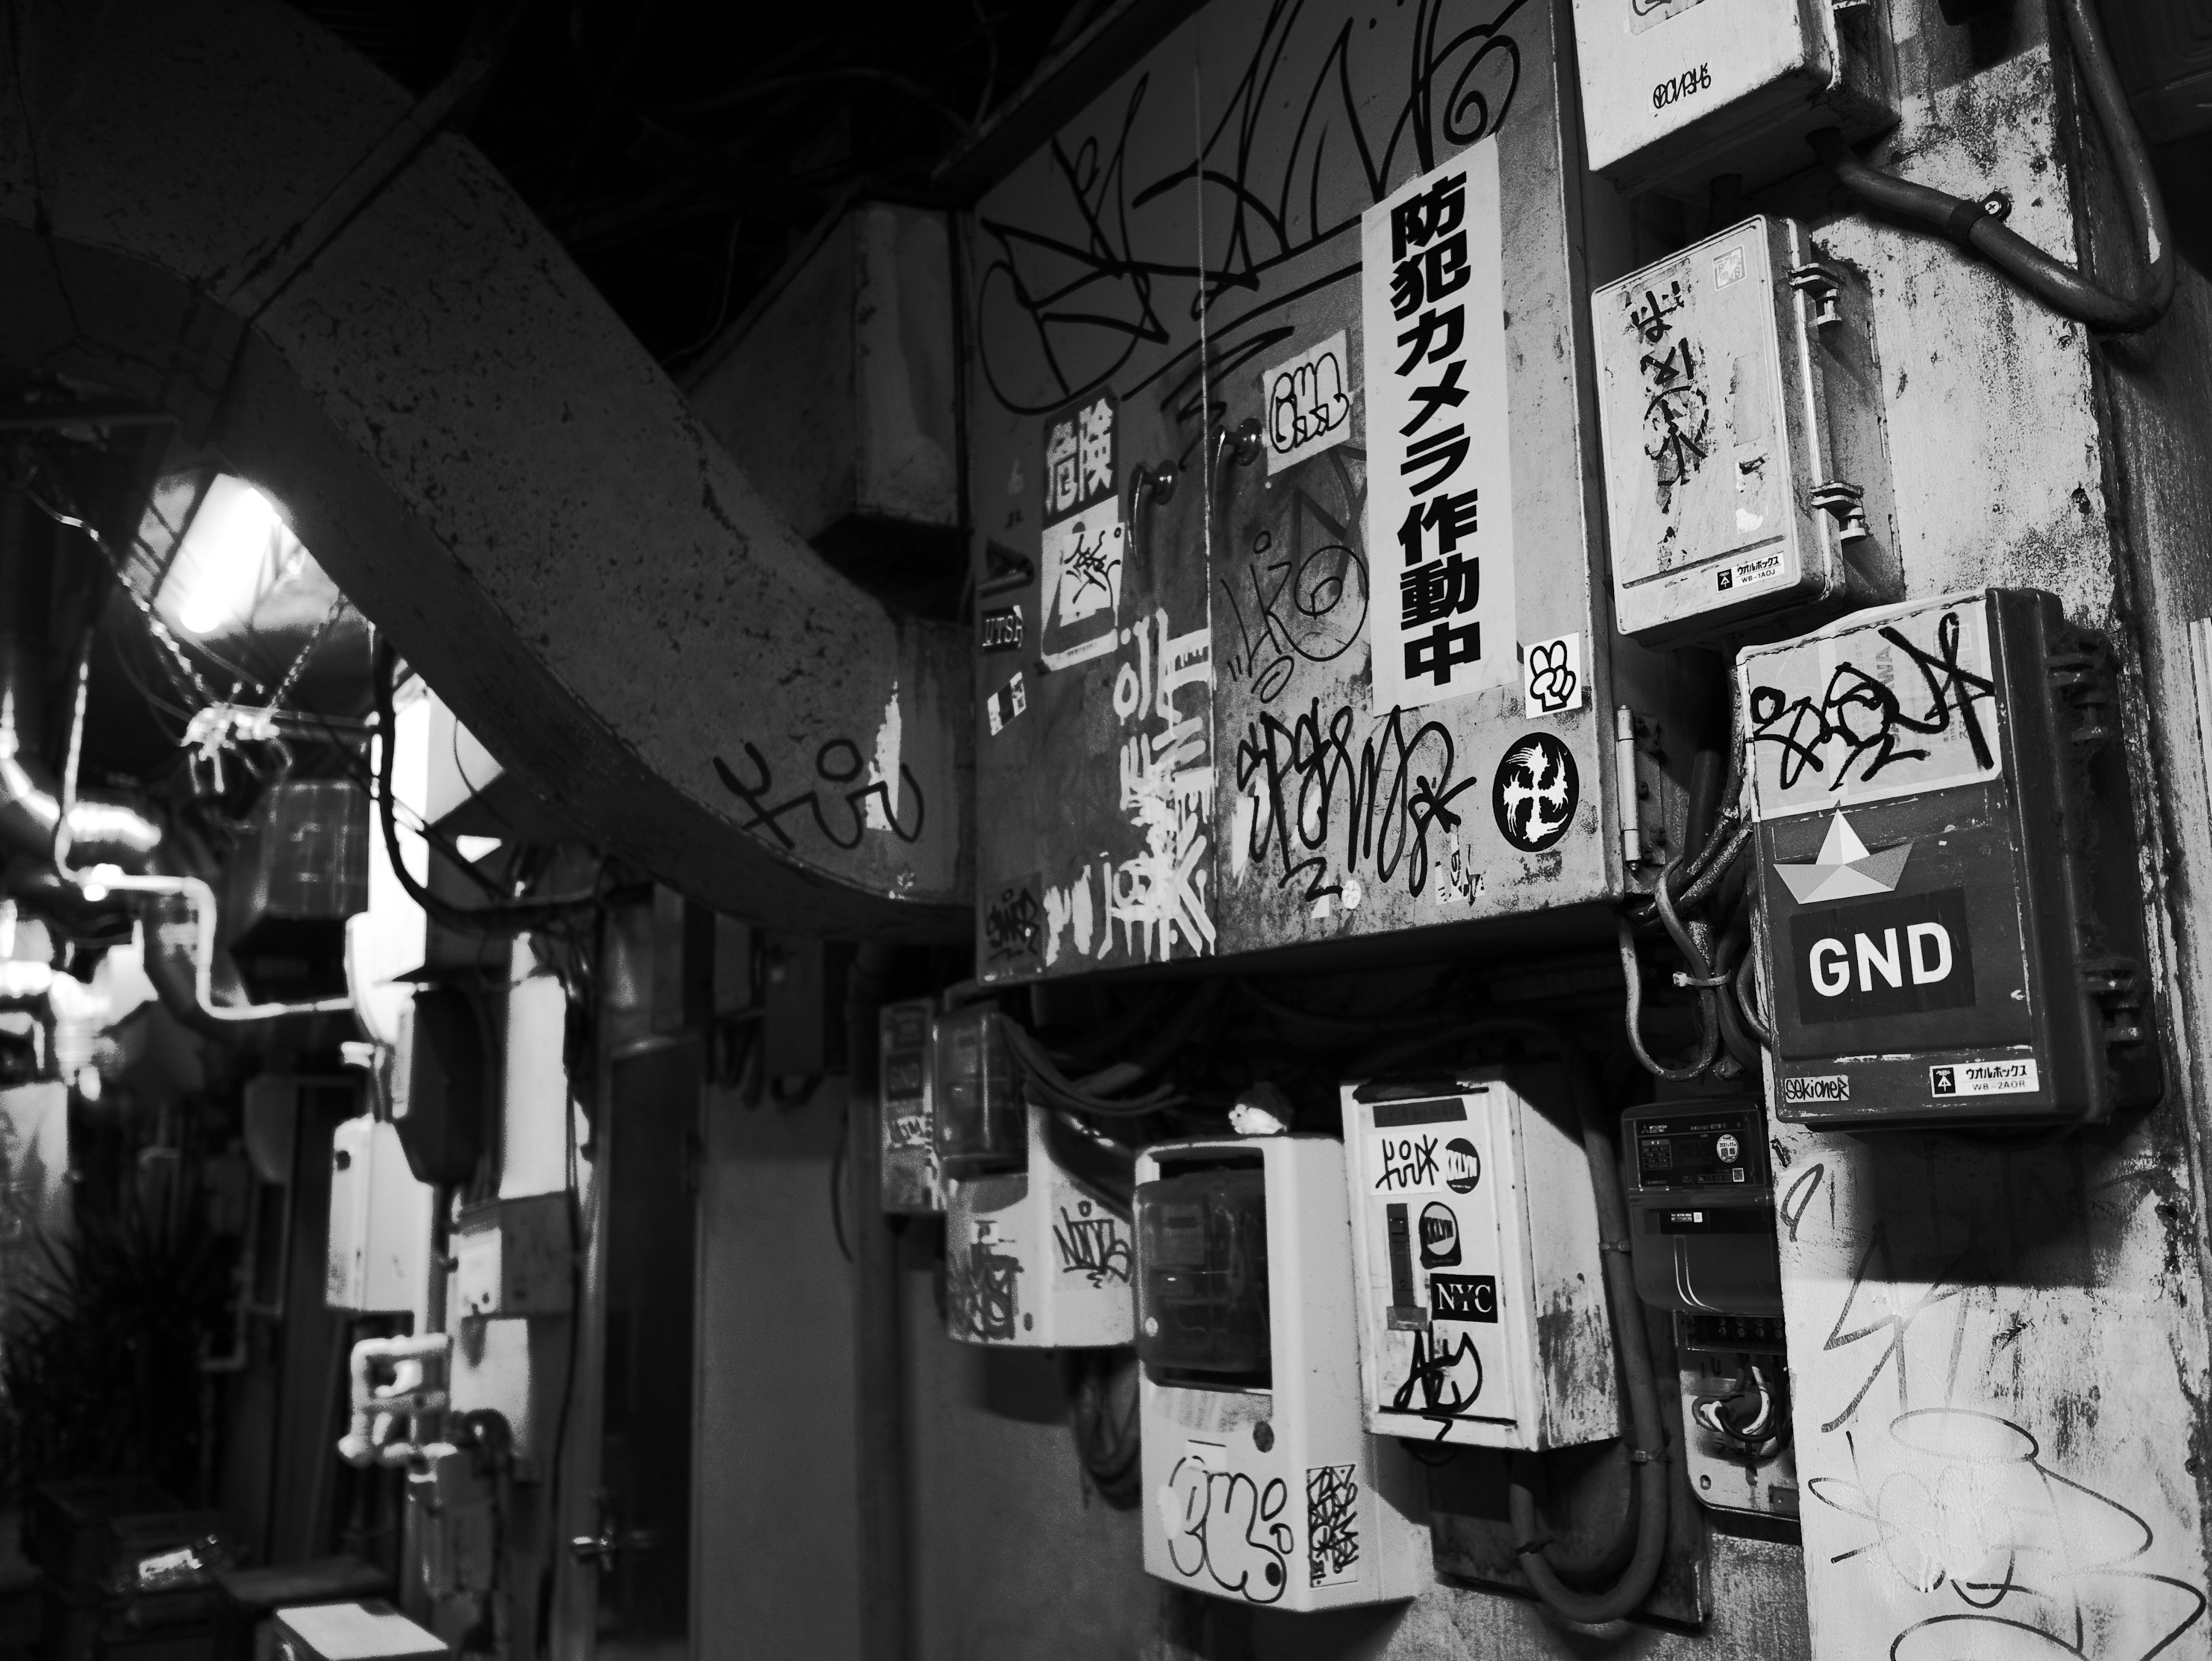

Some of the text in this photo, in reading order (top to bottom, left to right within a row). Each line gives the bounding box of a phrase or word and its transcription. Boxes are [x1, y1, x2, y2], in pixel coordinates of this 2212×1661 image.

[1044, 398, 1114, 514] 危険
[1390, 171, 1481, 686] 防犯カメラ作動中
[1808, 921, 1953, 997] GND
[1436, 1282, 1493, 1314] NYC
